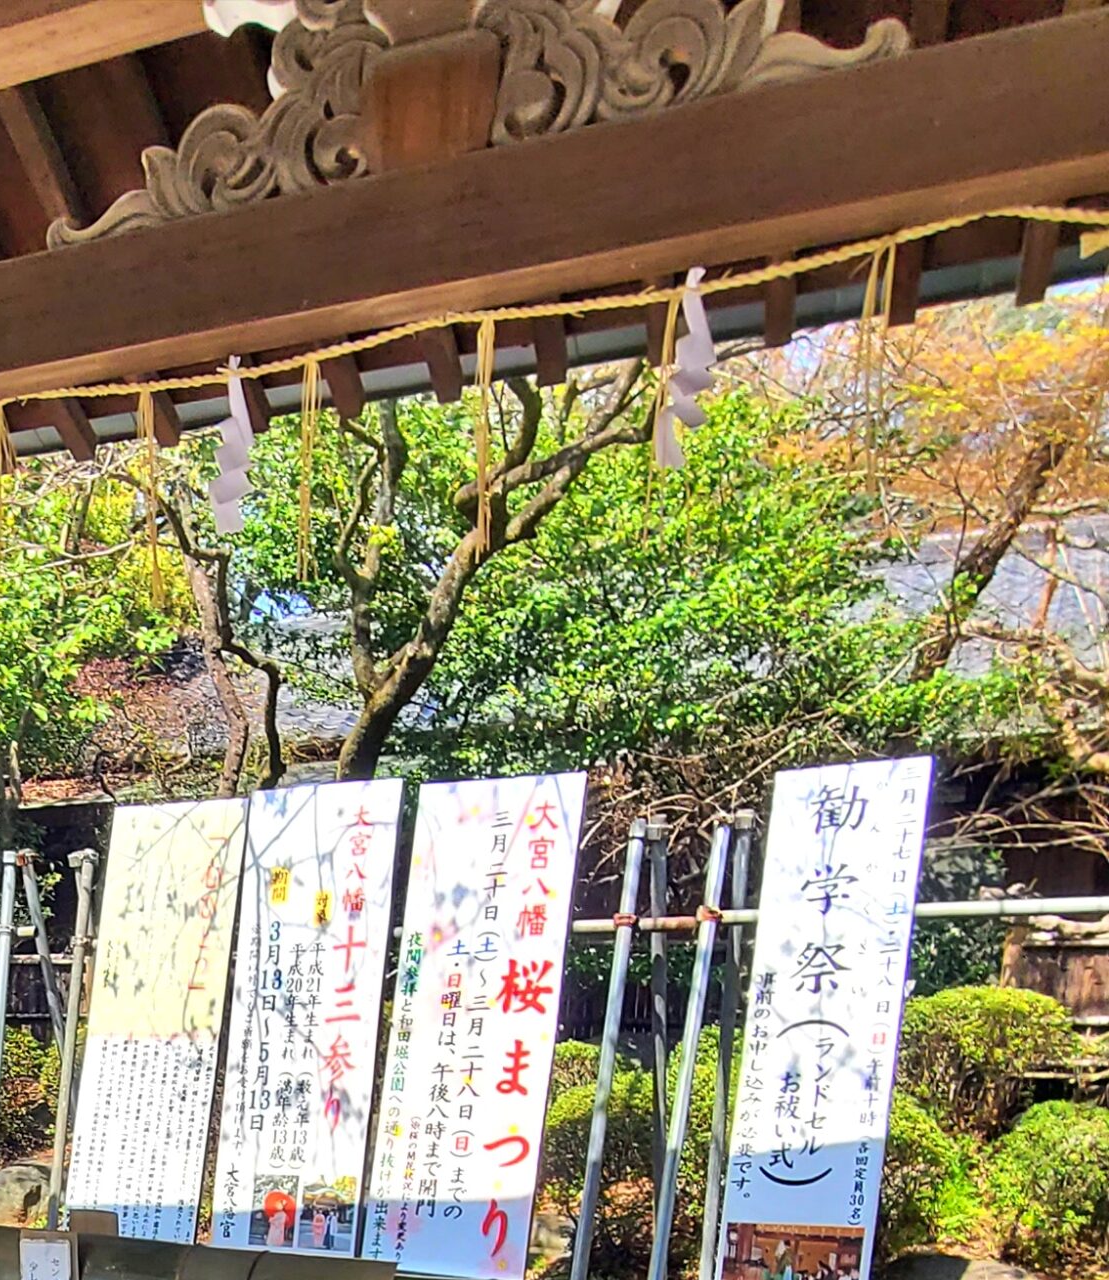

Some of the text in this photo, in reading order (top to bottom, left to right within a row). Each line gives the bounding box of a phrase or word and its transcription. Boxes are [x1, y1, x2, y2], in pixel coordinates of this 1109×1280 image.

[320, 804, 373, 1137] 大宮八幡 十三参り
[790, 784, 869, 995] 勧学祭
[480, 799, 559, 1258] 大宮八幡 桜まつり
[730, 971, 778, 1200] 事前のお申し込みが必要です。
[768, 1070, 802, 1170] お祓い式
[798, 1036, 835, 1156] ランドセル
[219, 1162, 240, 1240] 大宮八幡宮
